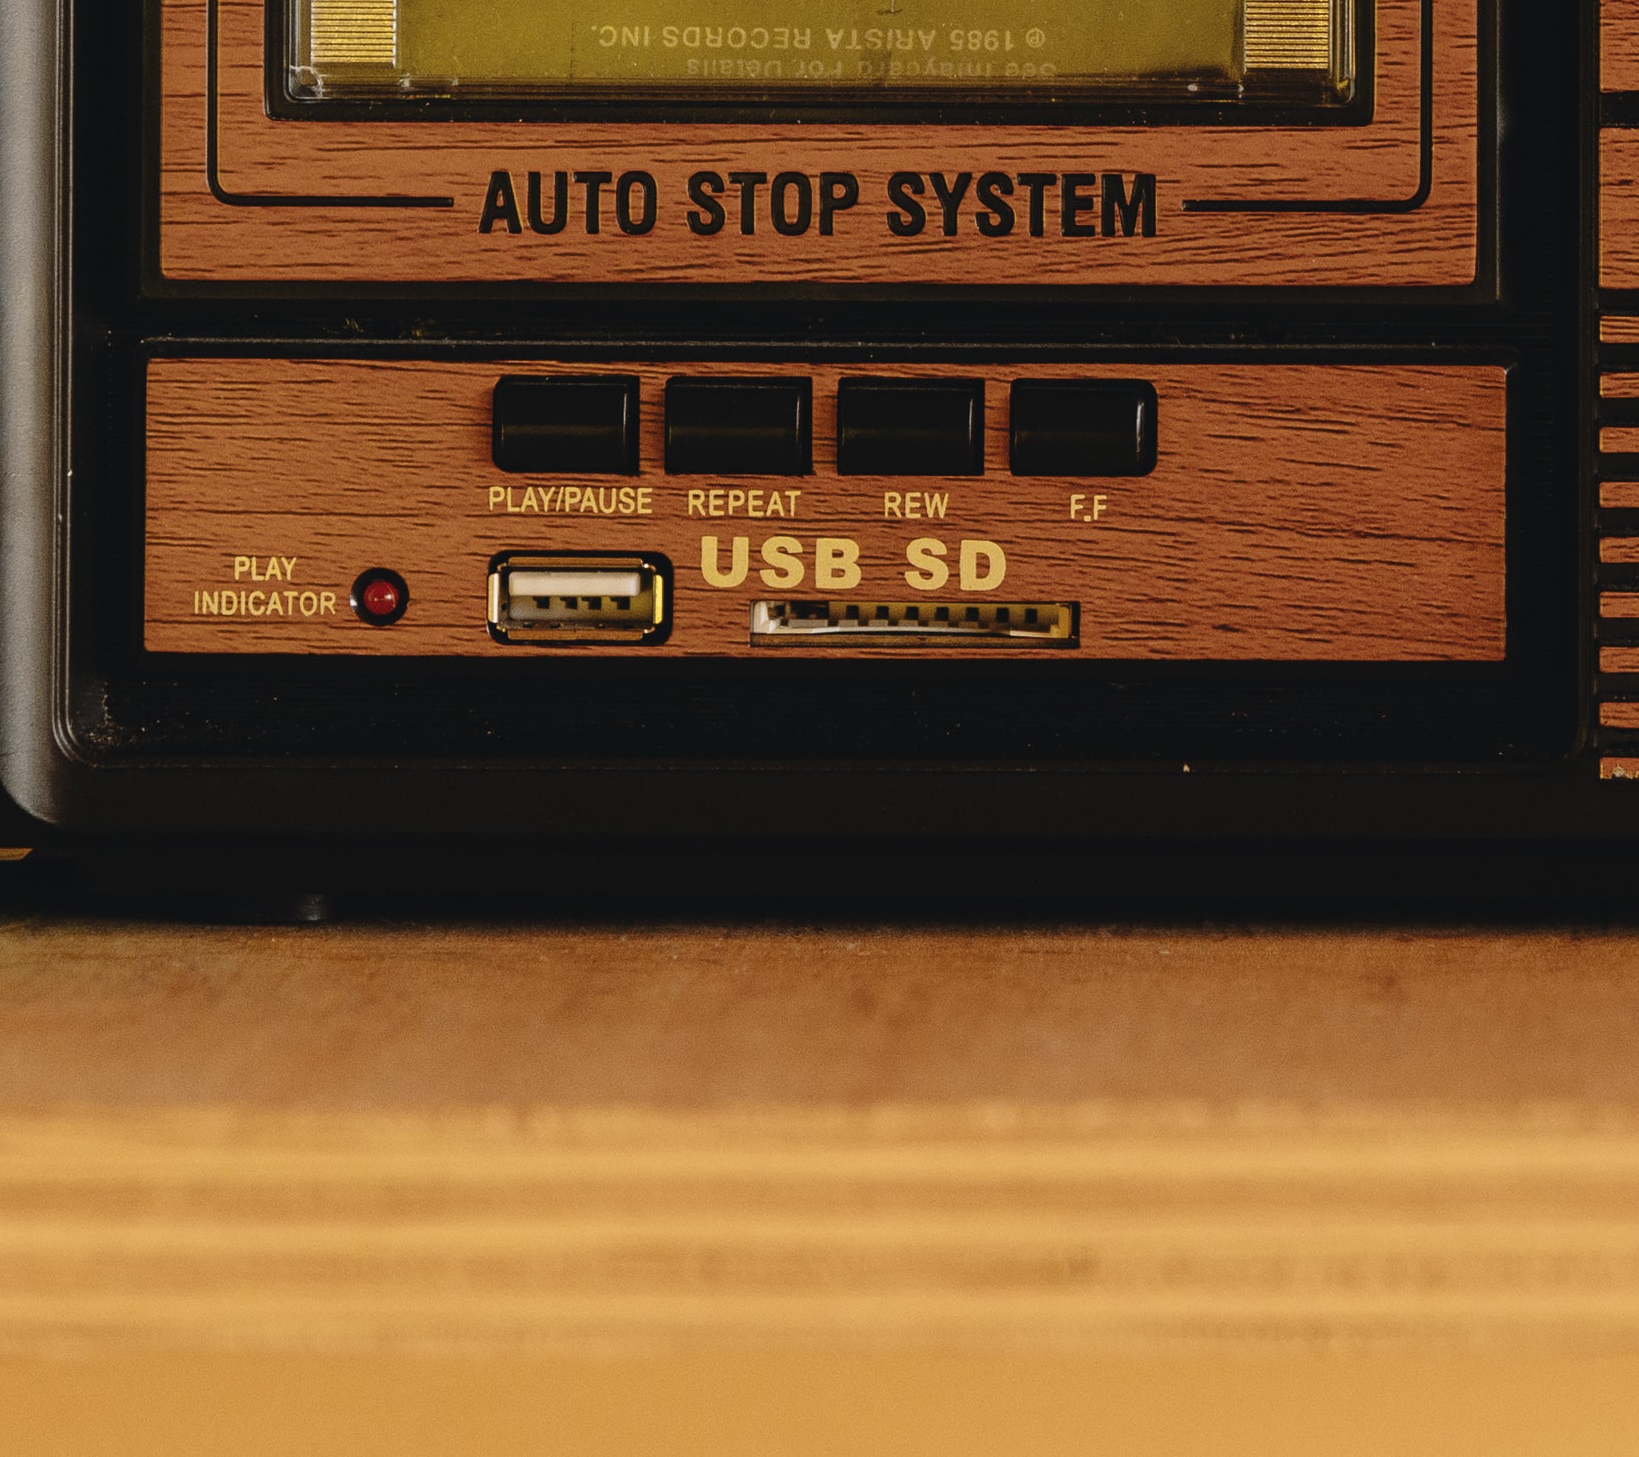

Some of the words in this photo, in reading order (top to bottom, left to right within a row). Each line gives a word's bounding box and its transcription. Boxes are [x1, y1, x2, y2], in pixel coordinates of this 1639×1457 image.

[591, 26, 649, 46] INC.
[663, 26, 810, 48] RECORDS
[826, 28, 936, 50] ARISTA
[950, 30, 1014, 51] 1985
[479, 171, 657, 234] AUTO
[687, 171, 859, 237] STOP
[887, 173, 1157, 237] SYSTEM
[489, 486, 653, 515] PLAY/PAUSE
[688, 490, 800, 517] REPEAT
[884, 492, 950, 519] REW
[1070, 495, 1107, 522] F.F
[233, 557, 297, 583] PLAY
[701, 537, 862, 589] USB
[905, 540, 1007, 591] SD
[194, 590, 336, 617] INDICATOR
